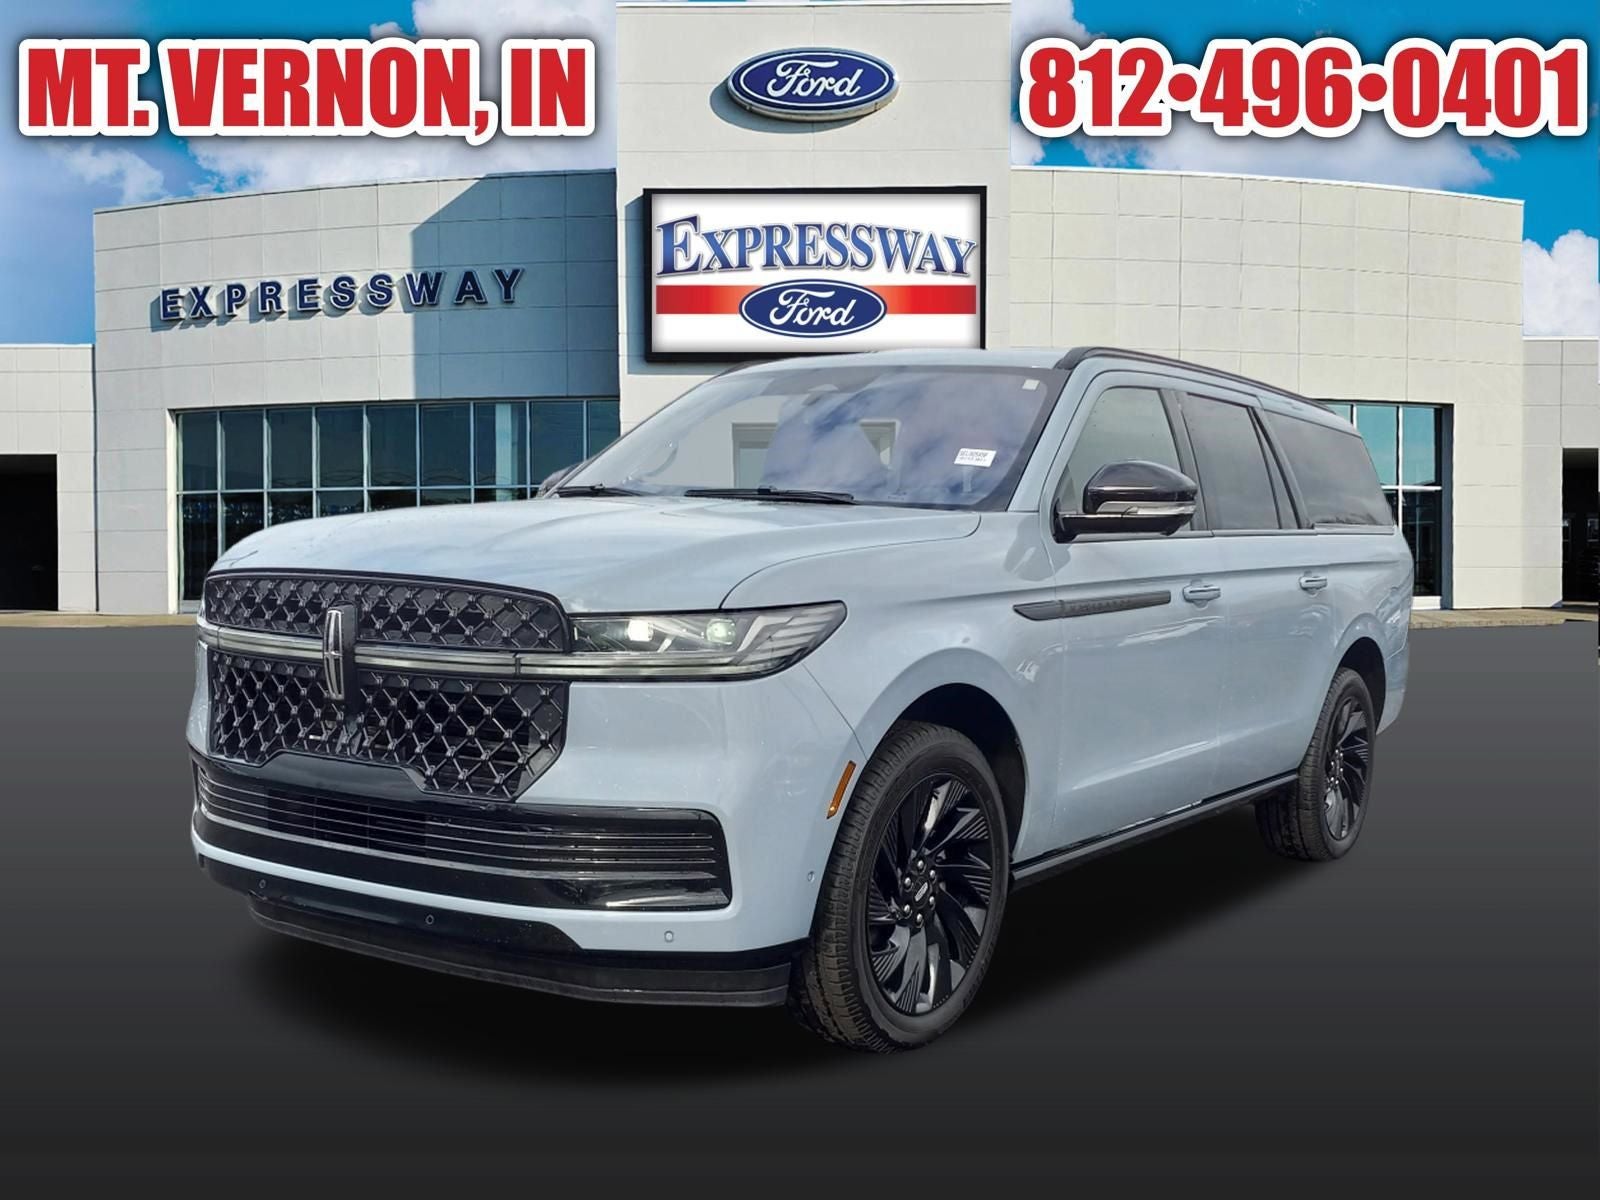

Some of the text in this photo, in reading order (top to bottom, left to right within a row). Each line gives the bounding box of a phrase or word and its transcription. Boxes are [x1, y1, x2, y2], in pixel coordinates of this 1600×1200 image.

[766, 59, 864, 97] Ford
[655, 213, 977, 278] EXPRESSWAY
[159, 268, 524, 321] EXPRESSWAY
[768, 288, 857, 326] Ford
